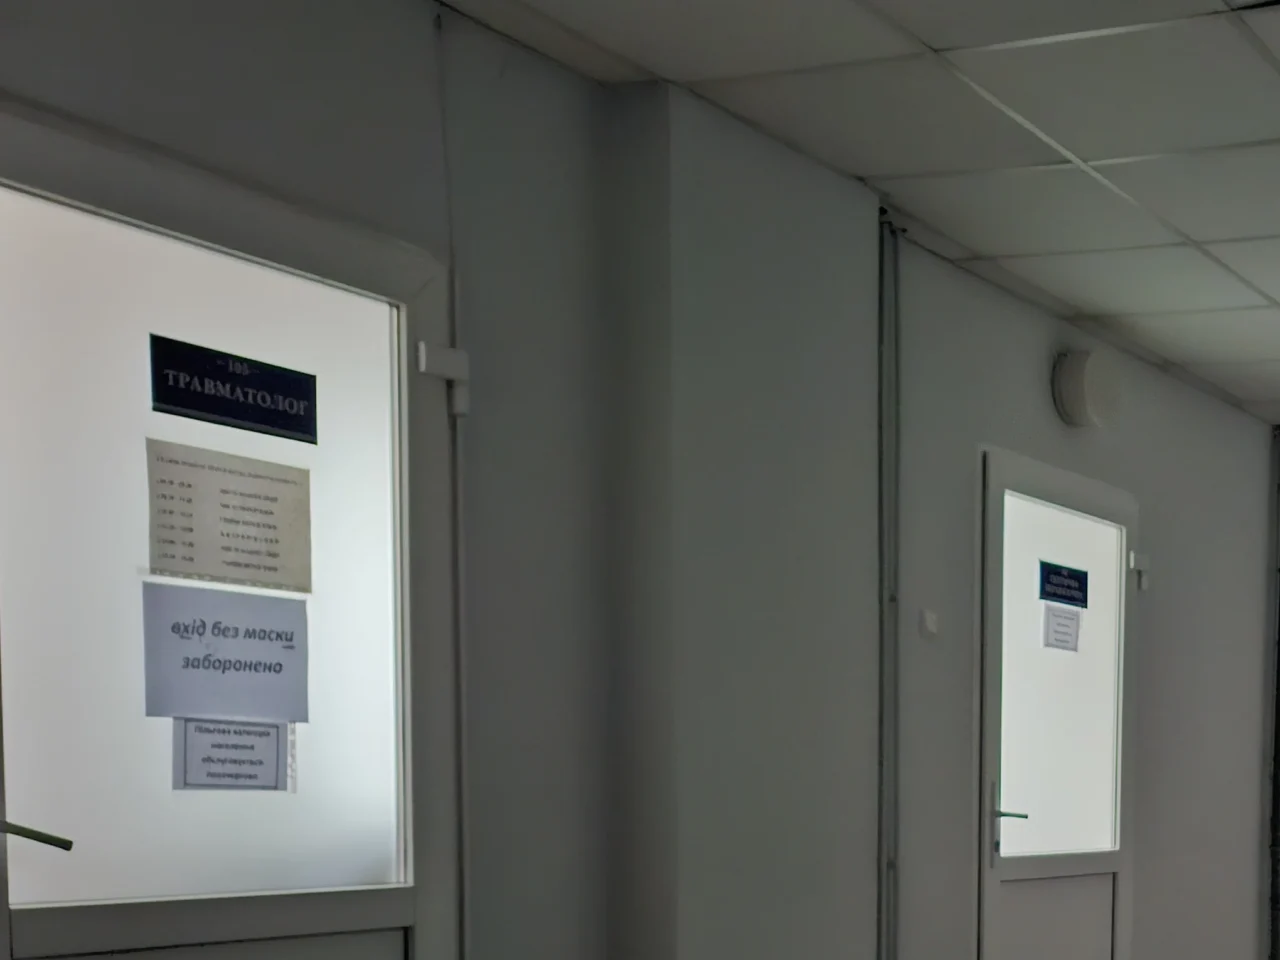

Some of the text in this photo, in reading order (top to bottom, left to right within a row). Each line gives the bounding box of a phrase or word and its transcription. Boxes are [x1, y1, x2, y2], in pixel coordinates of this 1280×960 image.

[164, 369, 308, 416] ТРАВМАТОЛОГ
[171, 618, 294, 643] вхід без маски
[181, 653, 283, 674] заборонено
